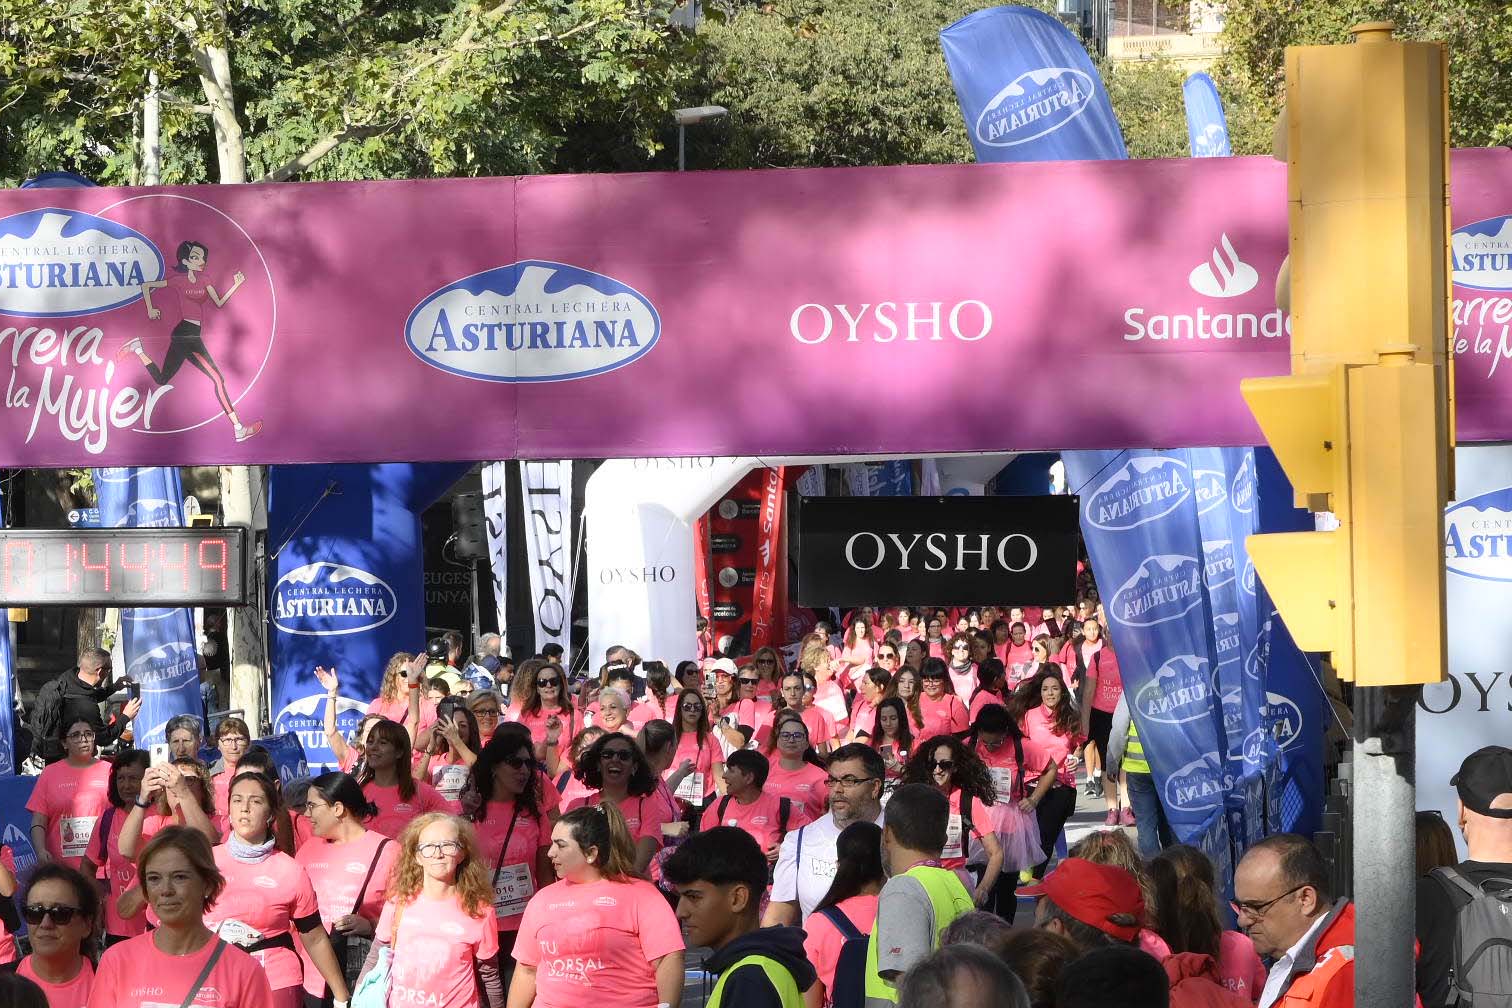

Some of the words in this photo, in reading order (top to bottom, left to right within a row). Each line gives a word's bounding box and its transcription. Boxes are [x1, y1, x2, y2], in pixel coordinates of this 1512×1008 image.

[67, 245, 140, 256] LECHERA
[464, 304, 543, 316] CENTRAL
[550, 301, 633, 313] LECHERA
[790, 299, 994, 345] OYSHO
[424, 307, 641, 351] ASTURIANA
[1474, 327, 1492, 354] la
[5, 367, 31, 409] la
[24, 359, 175, 455] Mujer
[845, 531, 1039, 573] OYSHO
[600, 565, 676, 585] OYSHO
[288, 588, 330, 596] CENTRAL
[335, 586, 383, 595] LECHERA
[275, 591, 389, 619] ASTURIANA
[496, 884, 514, 895] 016
